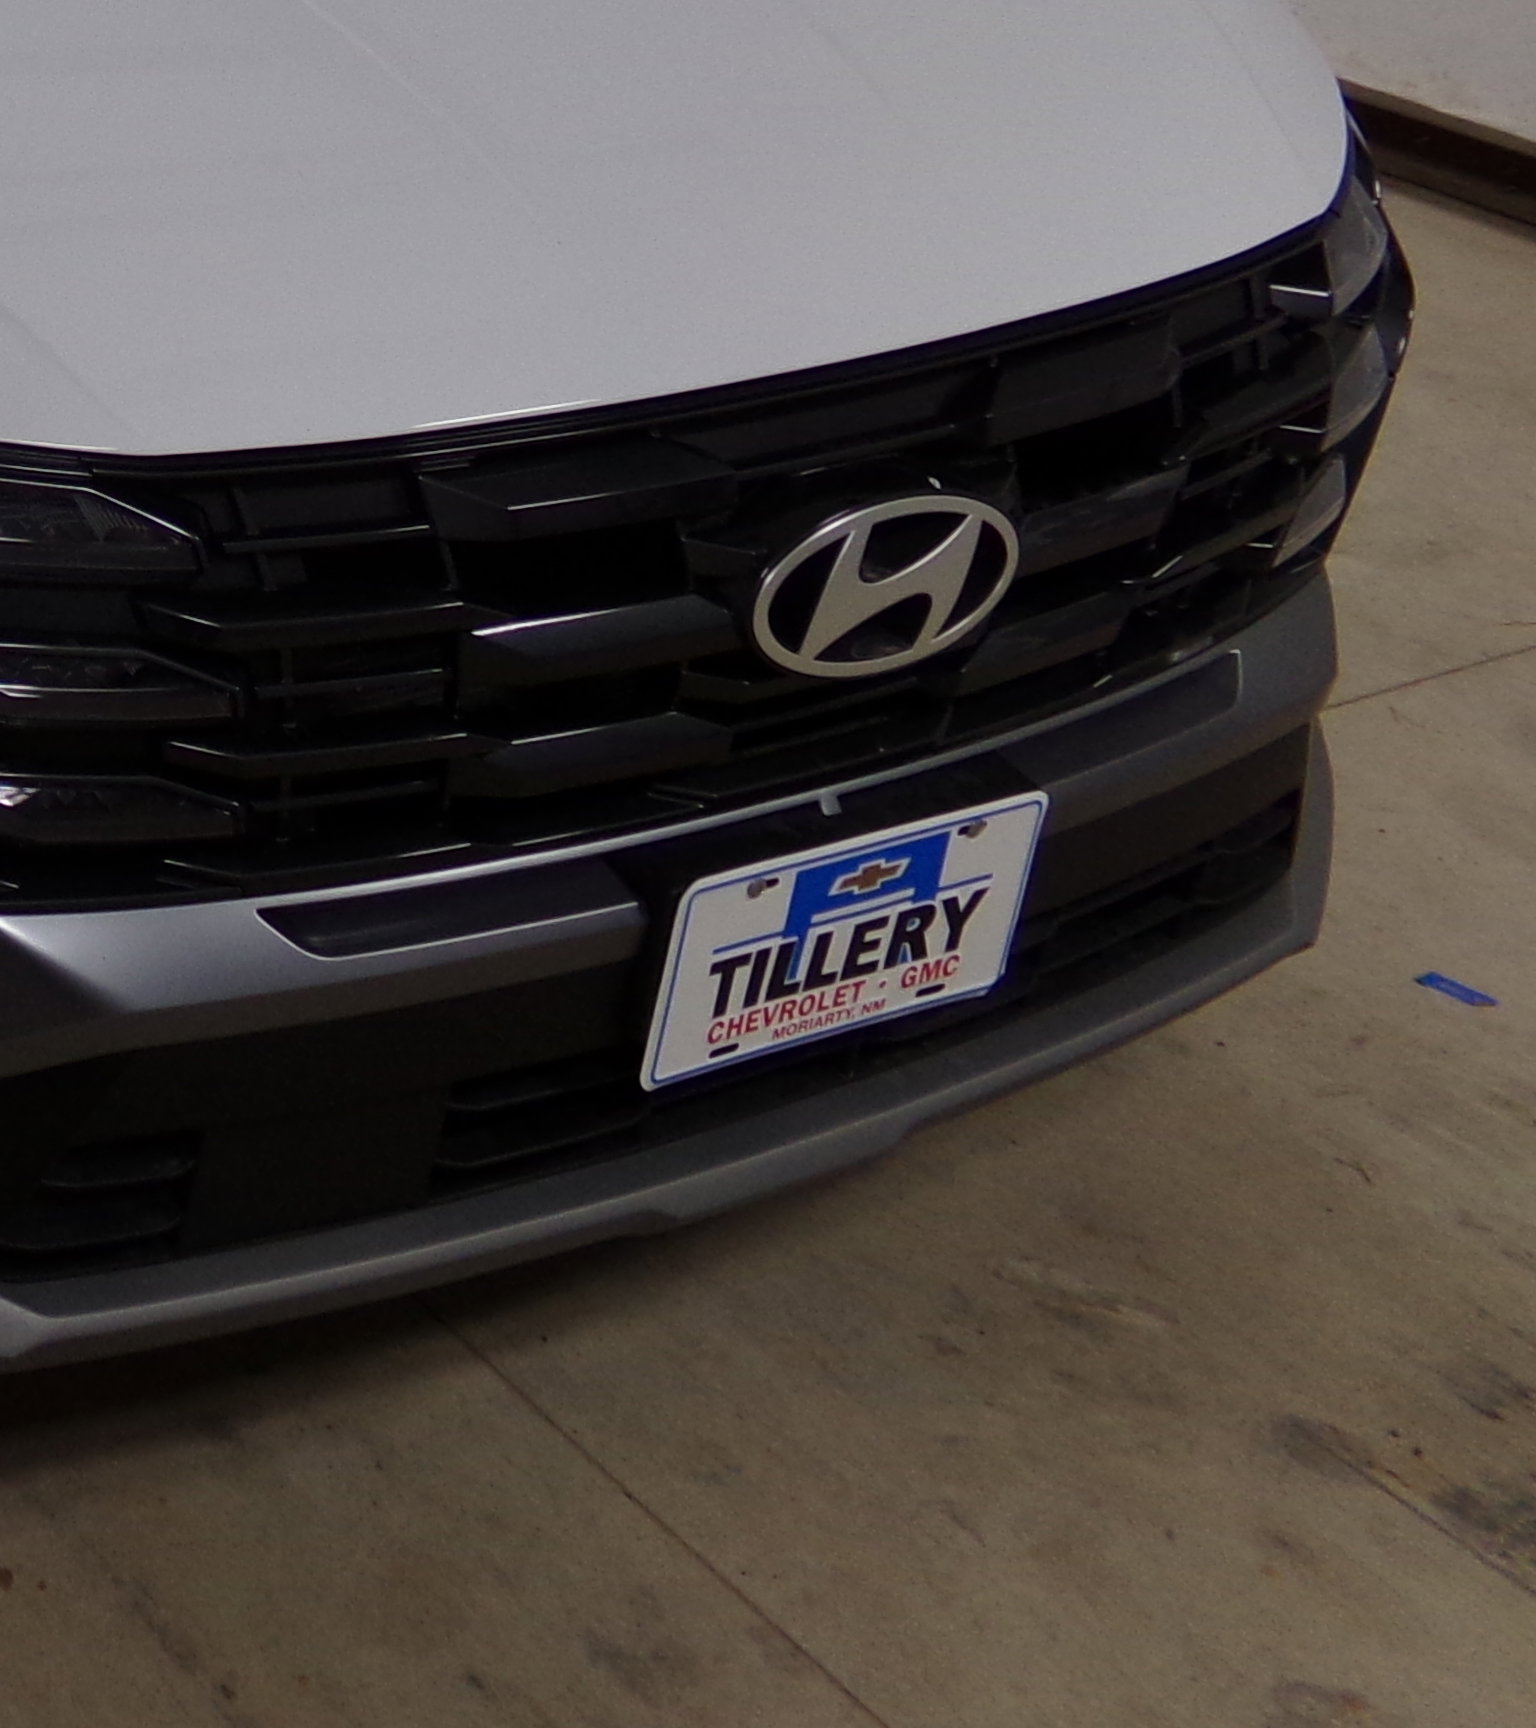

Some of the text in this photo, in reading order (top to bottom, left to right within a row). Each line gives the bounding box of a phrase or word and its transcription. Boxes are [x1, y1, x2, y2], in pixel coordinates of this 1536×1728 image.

[708, 886, 991, 1019] TILLERY
[706, 954, 961, 1045] CHEVROLET GMC
[861, 998, 886, 1015] NM
